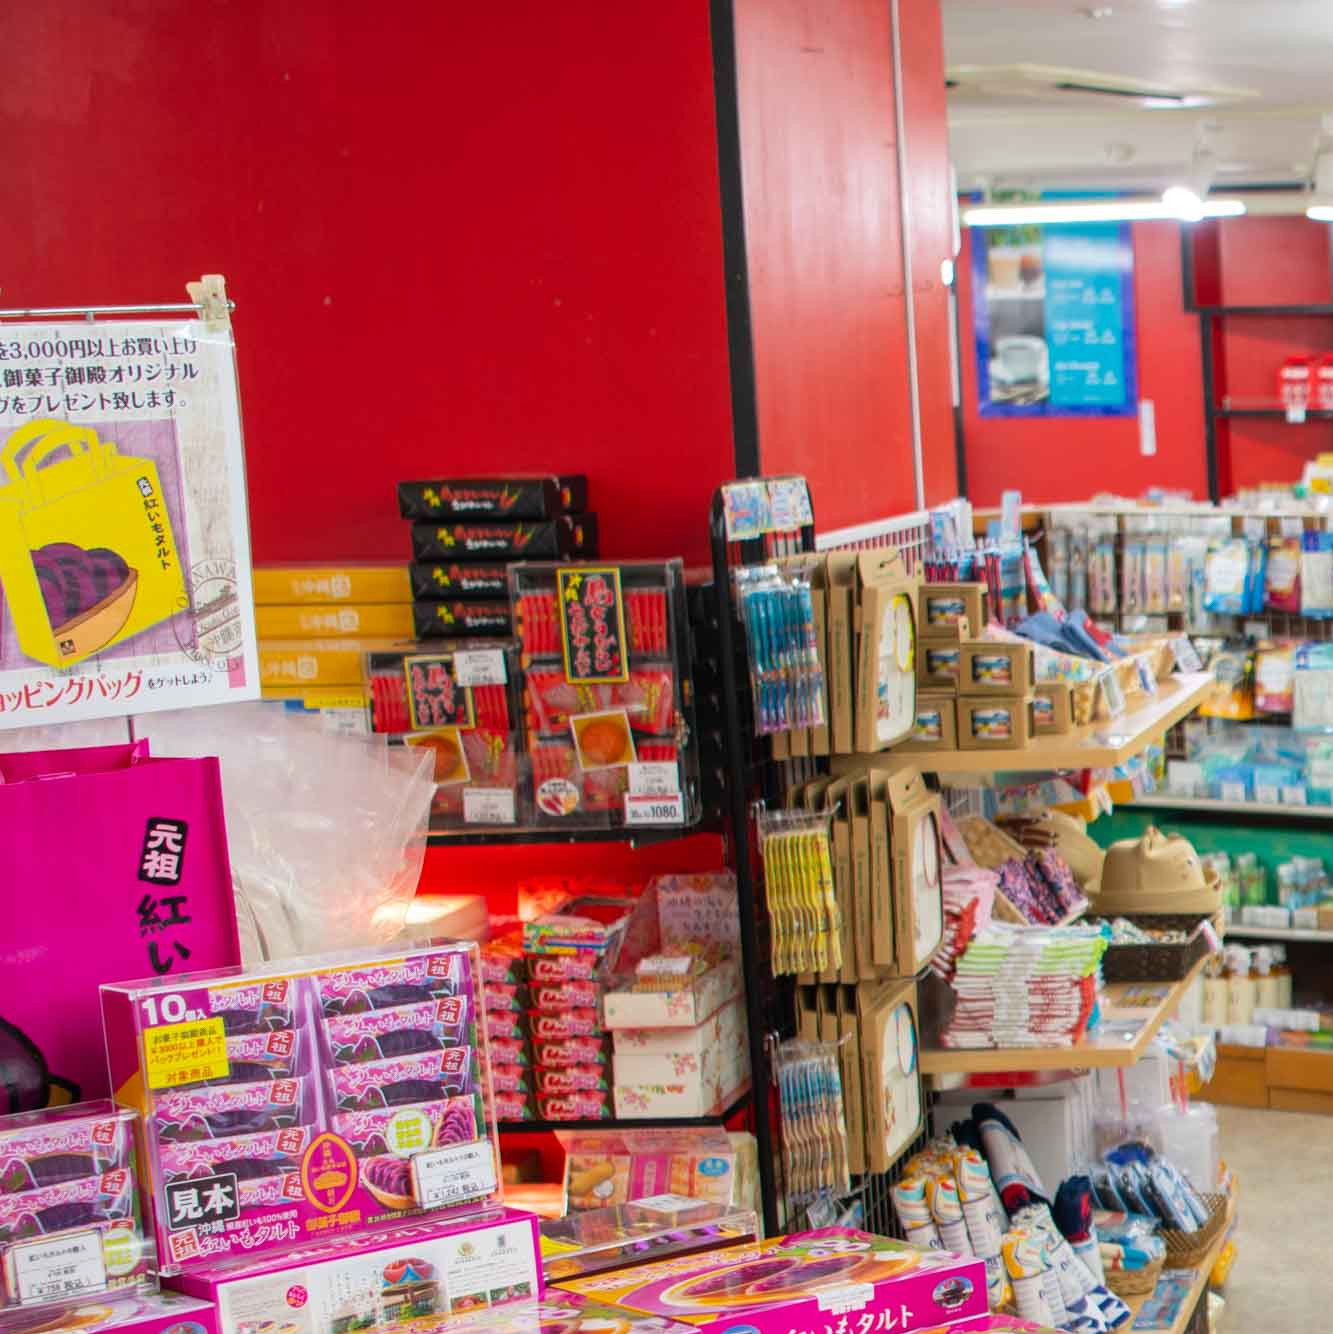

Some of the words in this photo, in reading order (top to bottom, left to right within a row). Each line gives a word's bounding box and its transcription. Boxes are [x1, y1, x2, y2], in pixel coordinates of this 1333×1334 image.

[0, 363, 199, 389] 御菓子御殿オリジナル
[141, 822, 183, 881] 元祖
[136, 894, 193, 975] 紅い
[268, 1031, 294, 1056] 元祖
[272, 1080, 298, 1105] 元祖
[173, 1184, 236, 1223] 見本
[199, 1223, 301, 1258] 紅いもタルト
